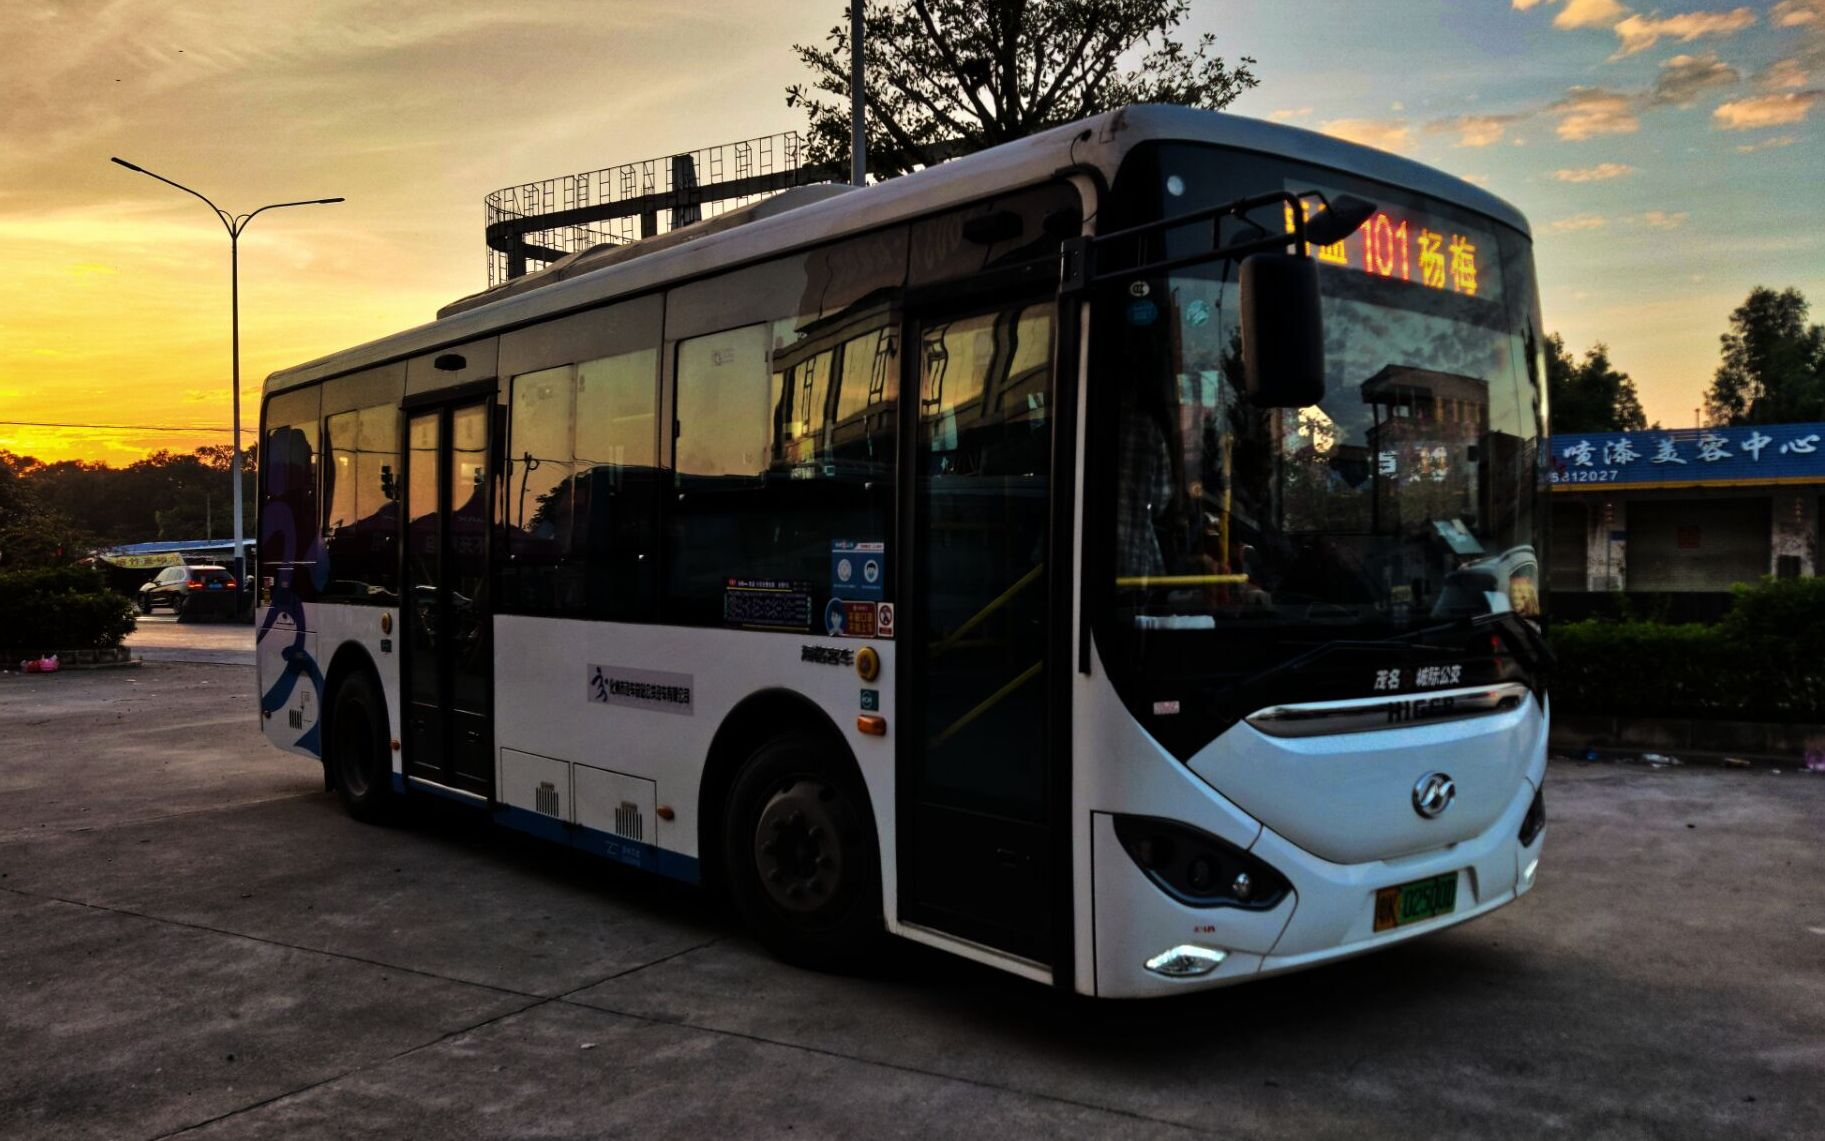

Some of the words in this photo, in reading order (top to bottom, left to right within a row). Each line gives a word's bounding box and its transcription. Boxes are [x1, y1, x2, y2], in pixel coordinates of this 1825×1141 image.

[1360, 213, 1410, 280] 101
[1417, 228, 1478, 296] 杨梅
[1563, 430, 1821, 467] 喷漆美容中心
[1374, 668, 1401, 690] 茂名
